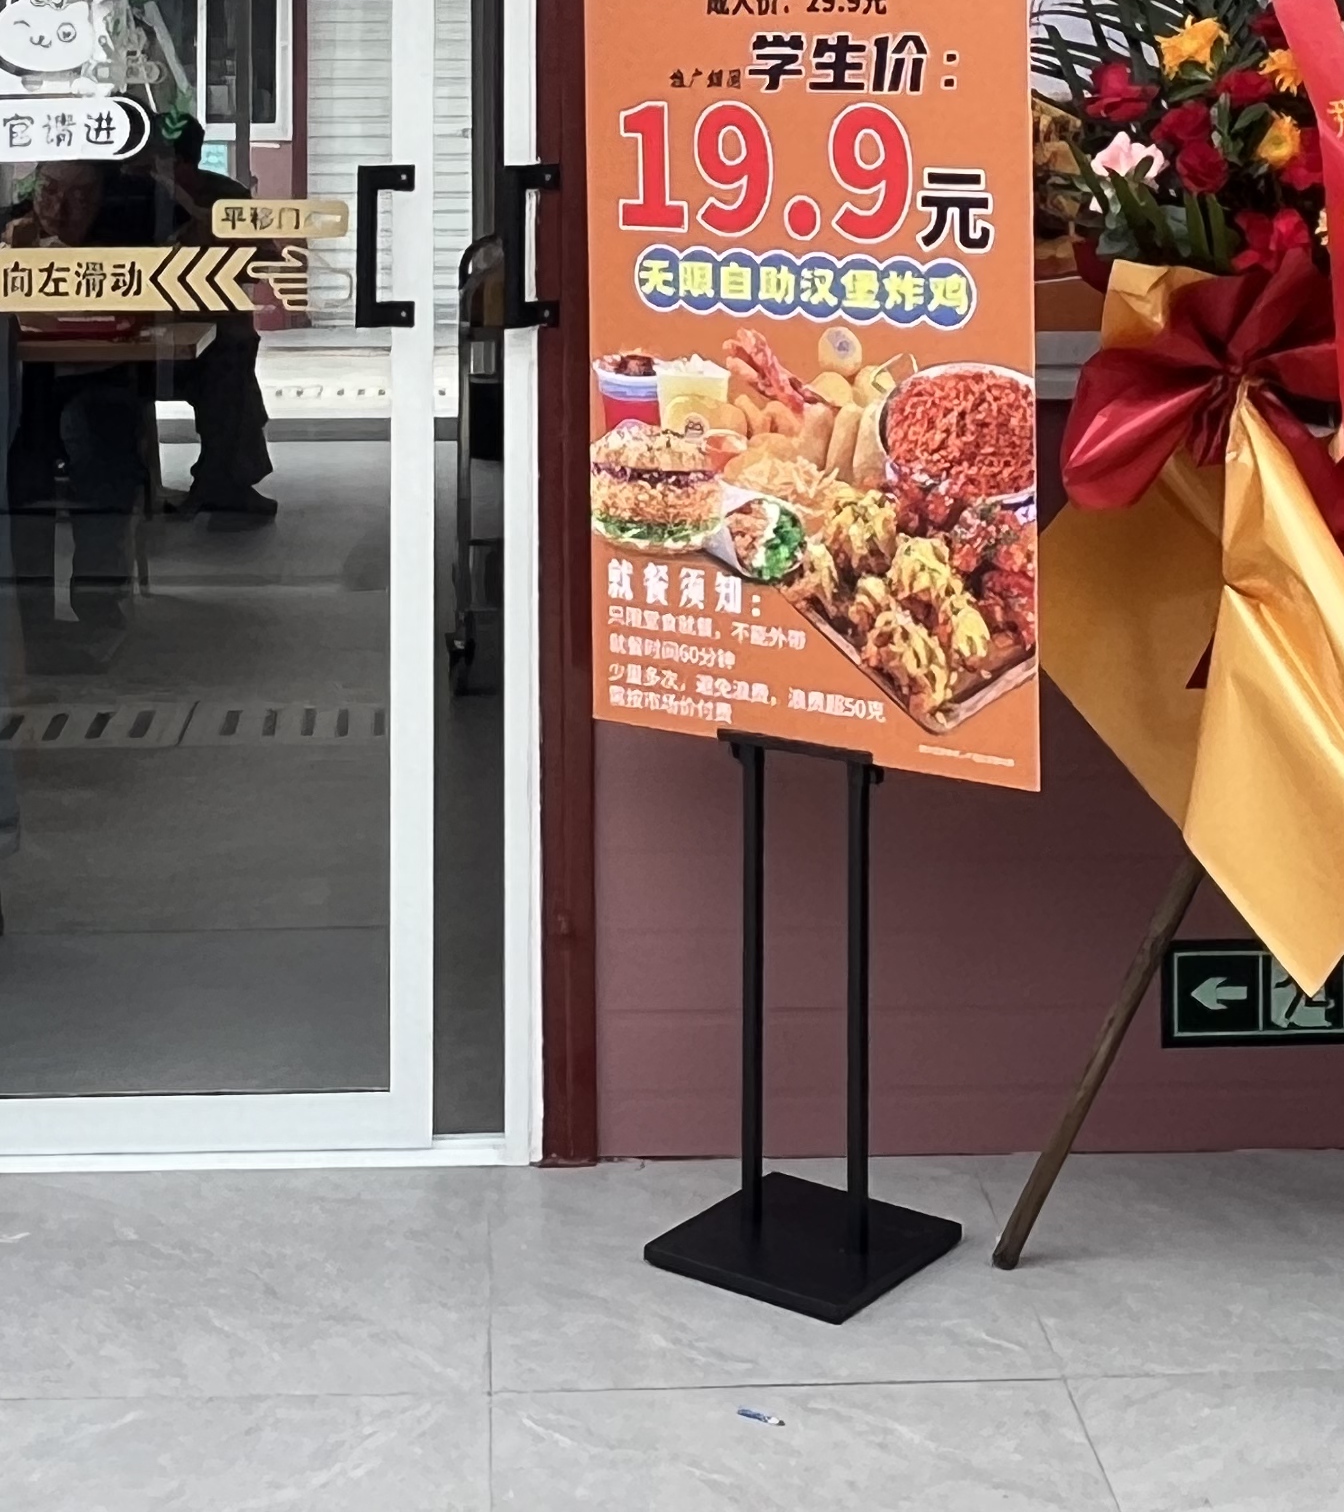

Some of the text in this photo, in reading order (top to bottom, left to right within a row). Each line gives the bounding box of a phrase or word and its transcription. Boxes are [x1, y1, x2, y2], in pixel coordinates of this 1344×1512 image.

[3, 261, 142, 297] 向左滑动
[639, 259, 968, 315] 无限自助汉堡炸鸡
